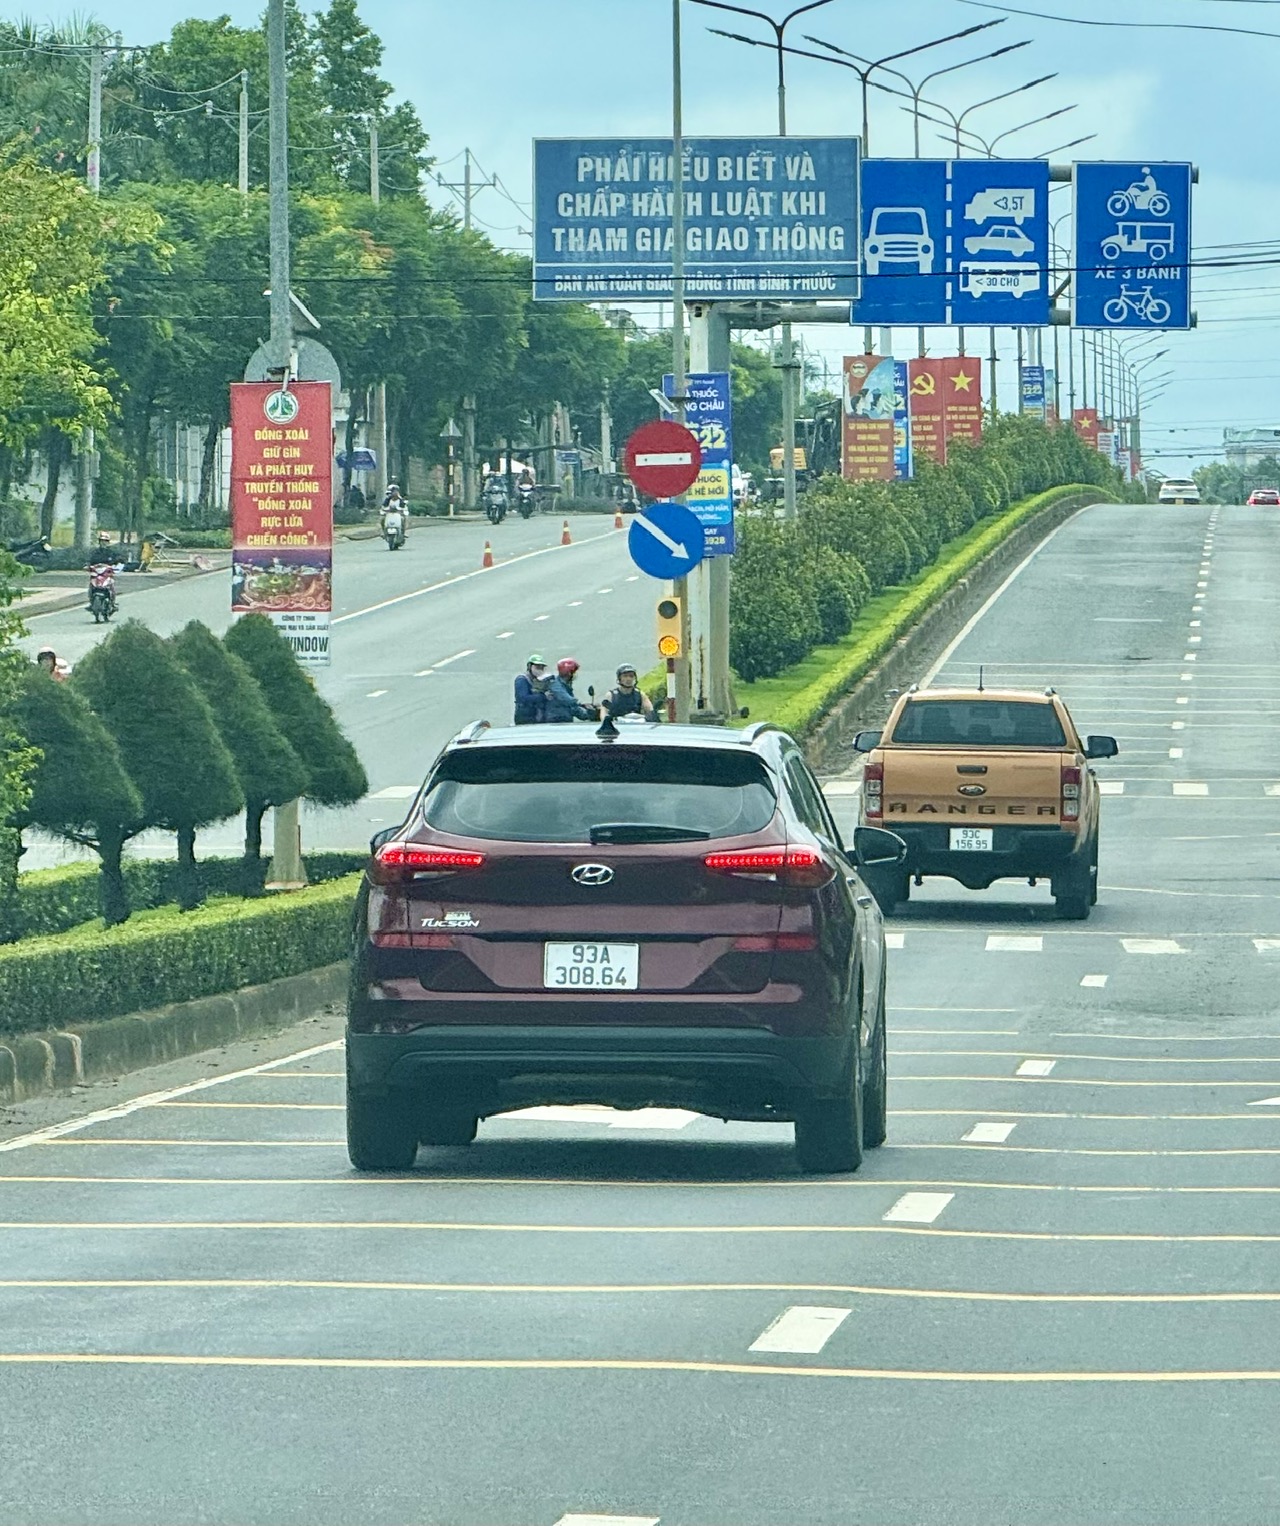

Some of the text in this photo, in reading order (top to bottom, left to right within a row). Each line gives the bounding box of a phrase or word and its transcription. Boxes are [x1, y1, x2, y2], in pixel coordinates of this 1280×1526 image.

[577, 146, 816, 182] PHẢI HIỂU BIẾT VÀ
[557, 185, 626, 217] CHẤP
[711, 187, 773, 222] LUẬT
[782, 191, 826, 216] KHI
[551, 222, 845, 252] THAM GIA GIAO THÔNG
[1095, 261, 1181, 280] XE 3 BÁNH
[554, 275, 583, 292] BAN
[586, 274, 605, 291] AN
[986, 277, 998, 287] 30
[699, 398, 725, 411] CHÂU
[285, 427, 309, 441] XOÀI
[249, 462, 314, 476] VÀ PHÁT HUY
[288, 496, 312, 511] XOÀI
[888, 802, 1056, 816] RANGER
[961, 829, 981, 839] 93C
[420, 917, 480, 928] TUCSON
[572, 945, 611, 965] 93A
[555, 966, 627, 986] 308.64
